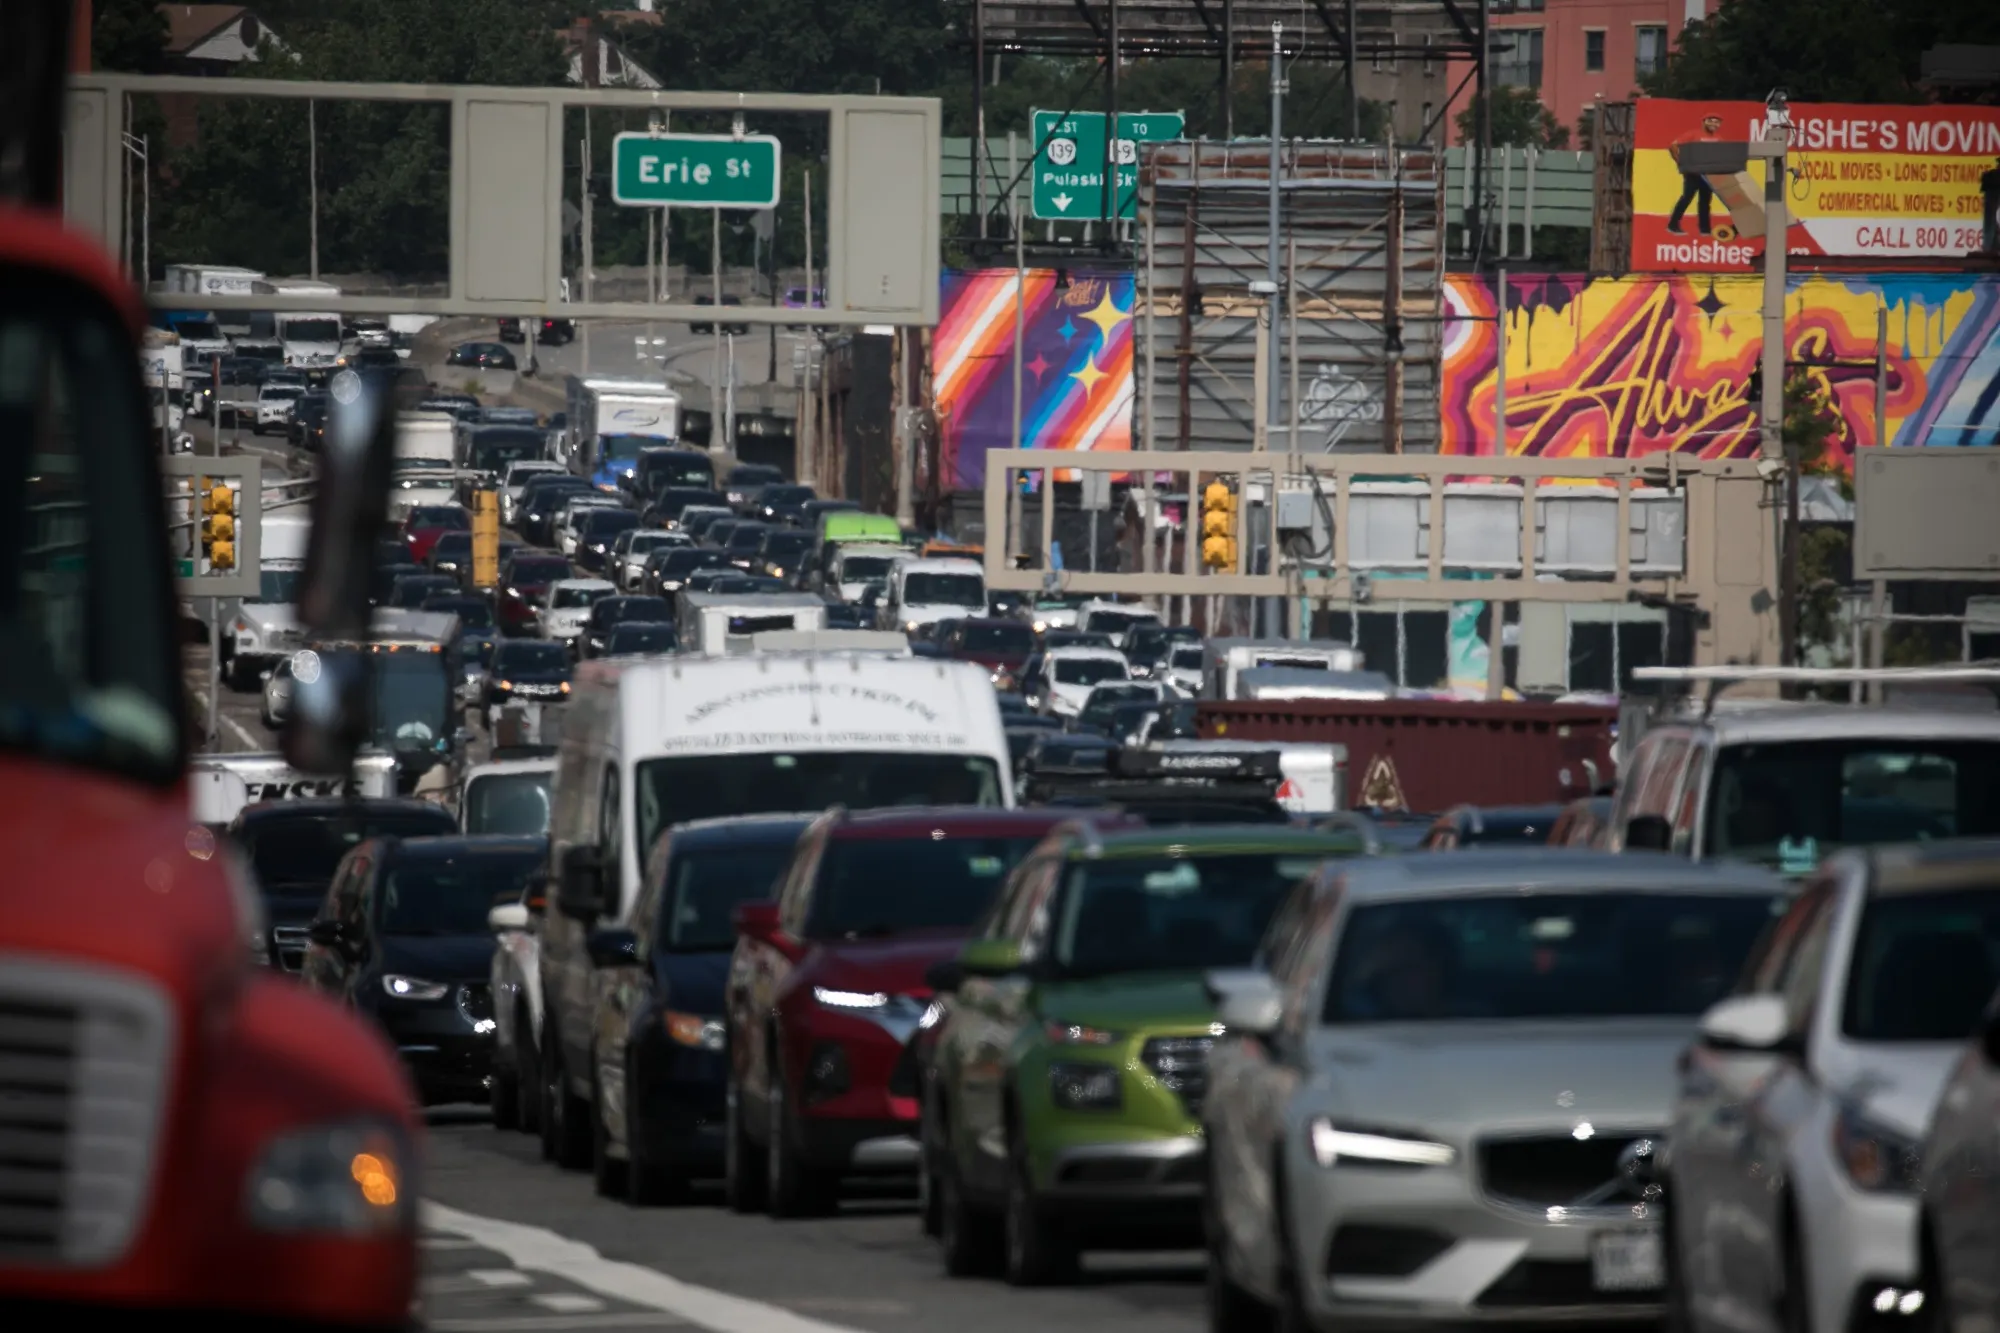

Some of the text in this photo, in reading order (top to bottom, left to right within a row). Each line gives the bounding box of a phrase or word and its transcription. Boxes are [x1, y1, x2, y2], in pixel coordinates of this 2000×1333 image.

[1046, 121, 1077, 133] WST
[1132, 123, 1148, 135] TO
[1051, 143, 1073, 159] 139
[639, 155, 752, 185] Erie St
[1799, 160, 1992, 183] LOCAL MOVES LONG DISTANC
[1818, 192, 1985, 214] COMMERCIAL MOVES STO
[1856, 226, 1909, 248] CALL
[1915, 227, 1948, 249] 800
